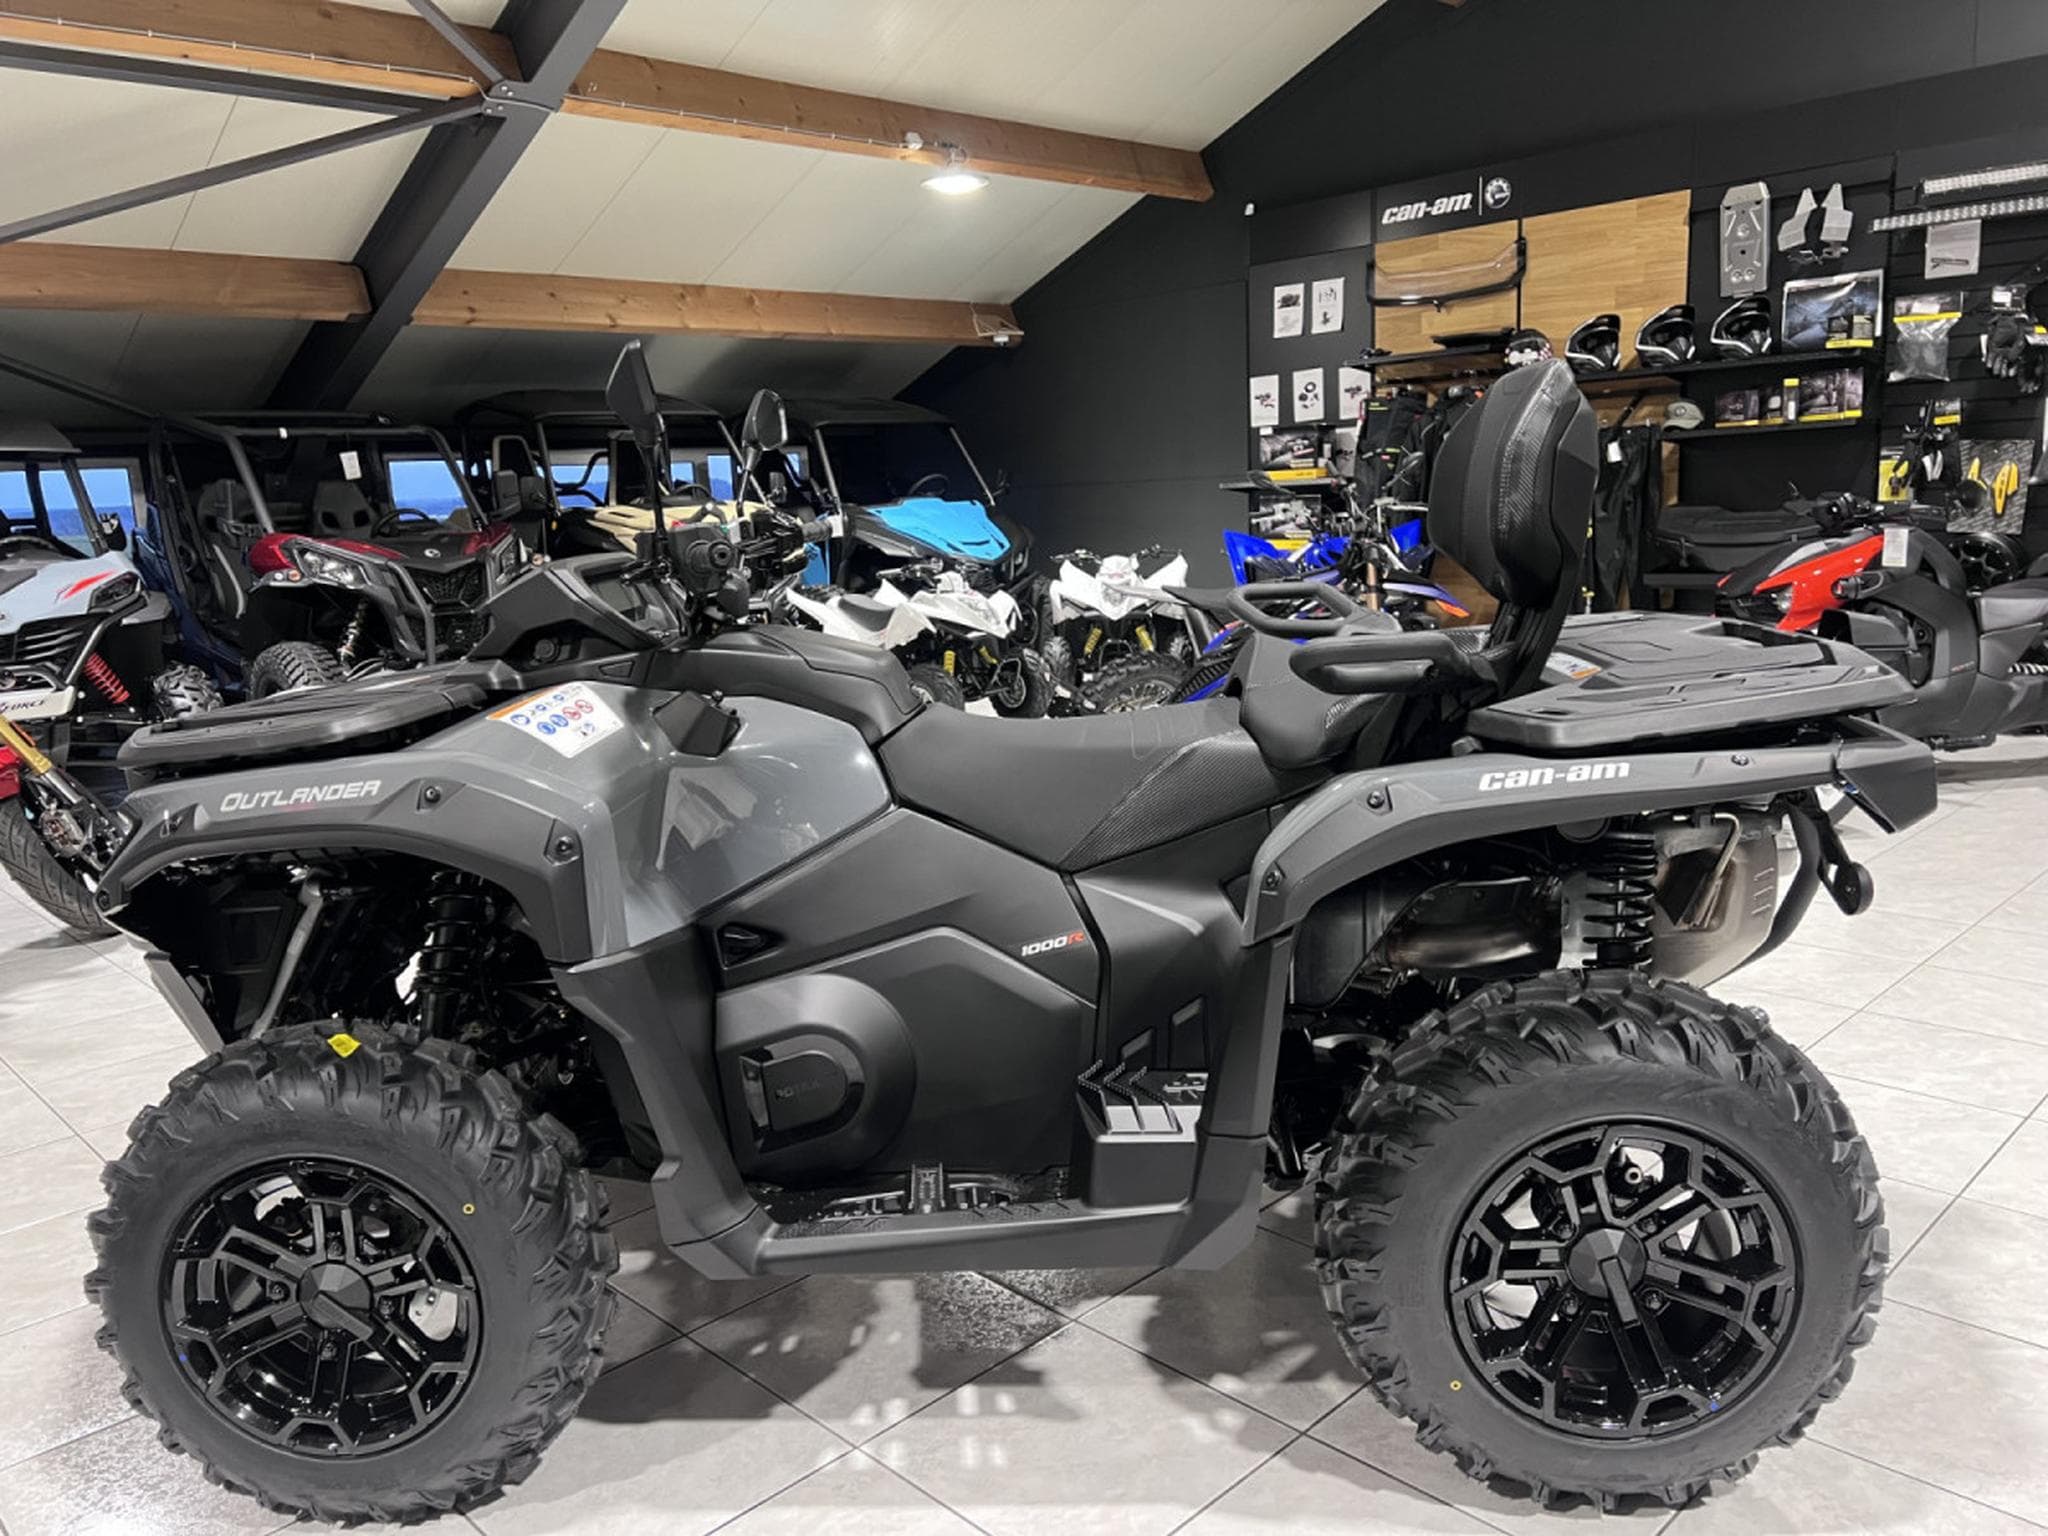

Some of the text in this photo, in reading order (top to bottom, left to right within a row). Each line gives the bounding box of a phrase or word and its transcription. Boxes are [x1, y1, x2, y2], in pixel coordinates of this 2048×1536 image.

[1381, 192, 1473, 224] can-am
[1478, 762, 1630, 791] can-am
[220, 779, 382, 812] OUTLANDER
[1021, 932, 1085, 957] 1000R
